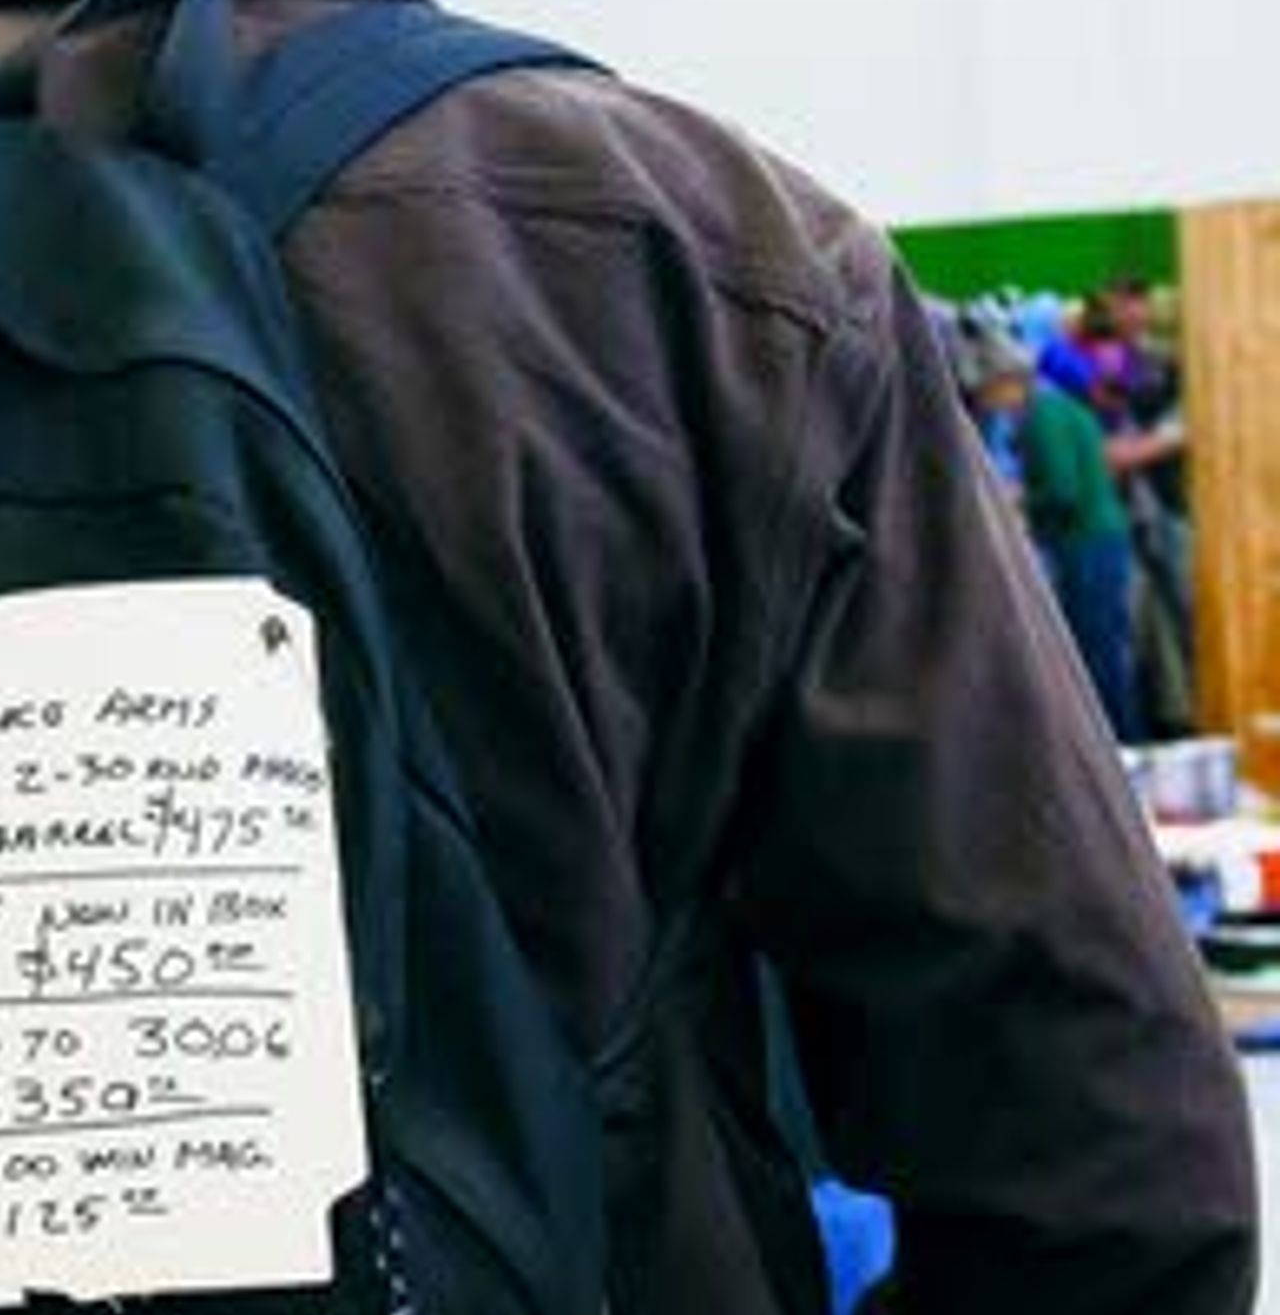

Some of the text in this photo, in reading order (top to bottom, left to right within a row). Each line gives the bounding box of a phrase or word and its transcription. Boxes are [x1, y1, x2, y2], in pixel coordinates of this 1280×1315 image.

[95, 688, 216, 727] ARMS
[153, 895, 193, 926] IN
[207, 891, 287, 925] BOX
[81, 1148, 156, 1175] WIN
